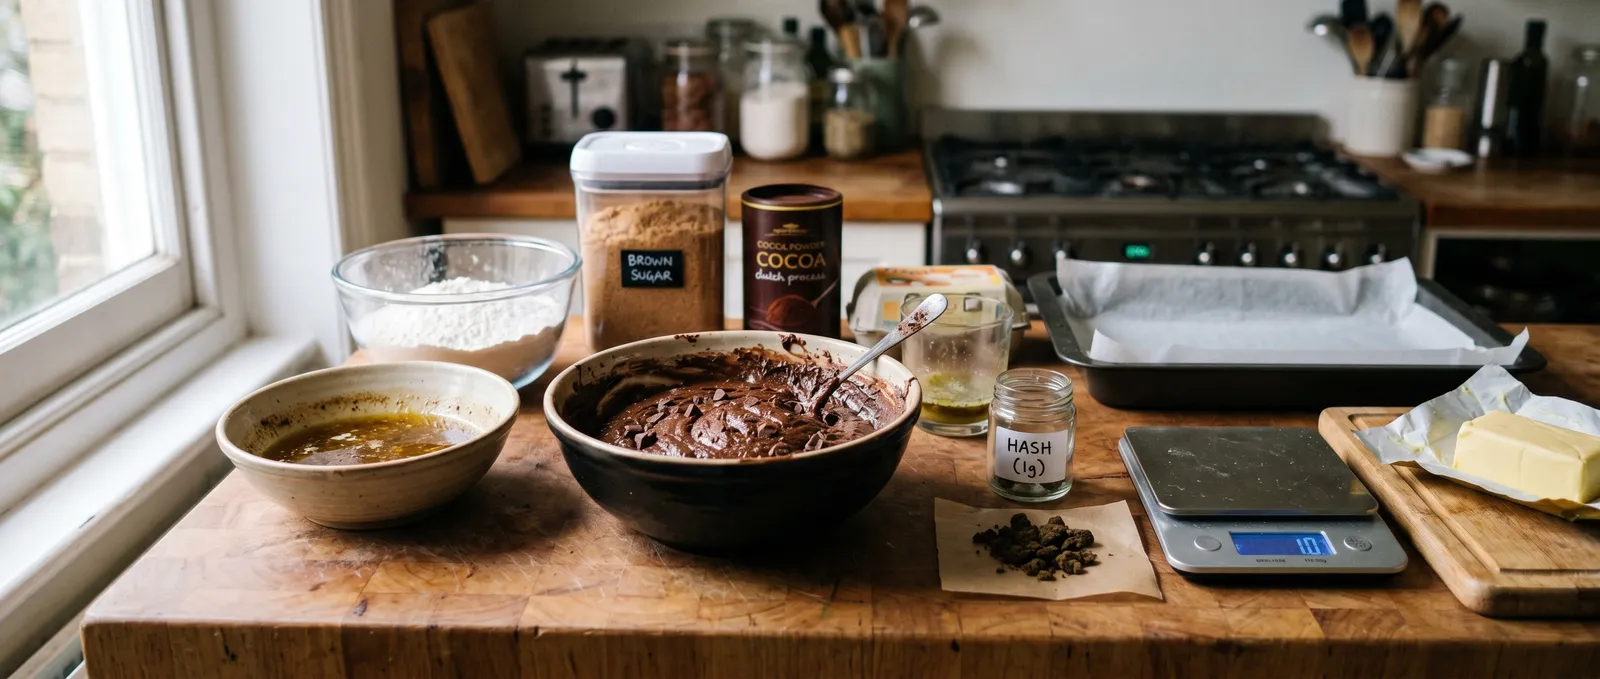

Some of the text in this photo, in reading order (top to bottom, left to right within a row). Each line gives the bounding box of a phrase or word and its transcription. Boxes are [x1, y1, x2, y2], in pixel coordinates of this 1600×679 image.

[627, 253, 673, 267] BROWN
[756, 251, 827, 269] COCOA
[631, 268, 673, 284] SUGAR
[755, 267, 785, 282] dutch
[1007, 437, 1052, 455] HASH
[1013, 457, 1045, 478] (1g)
